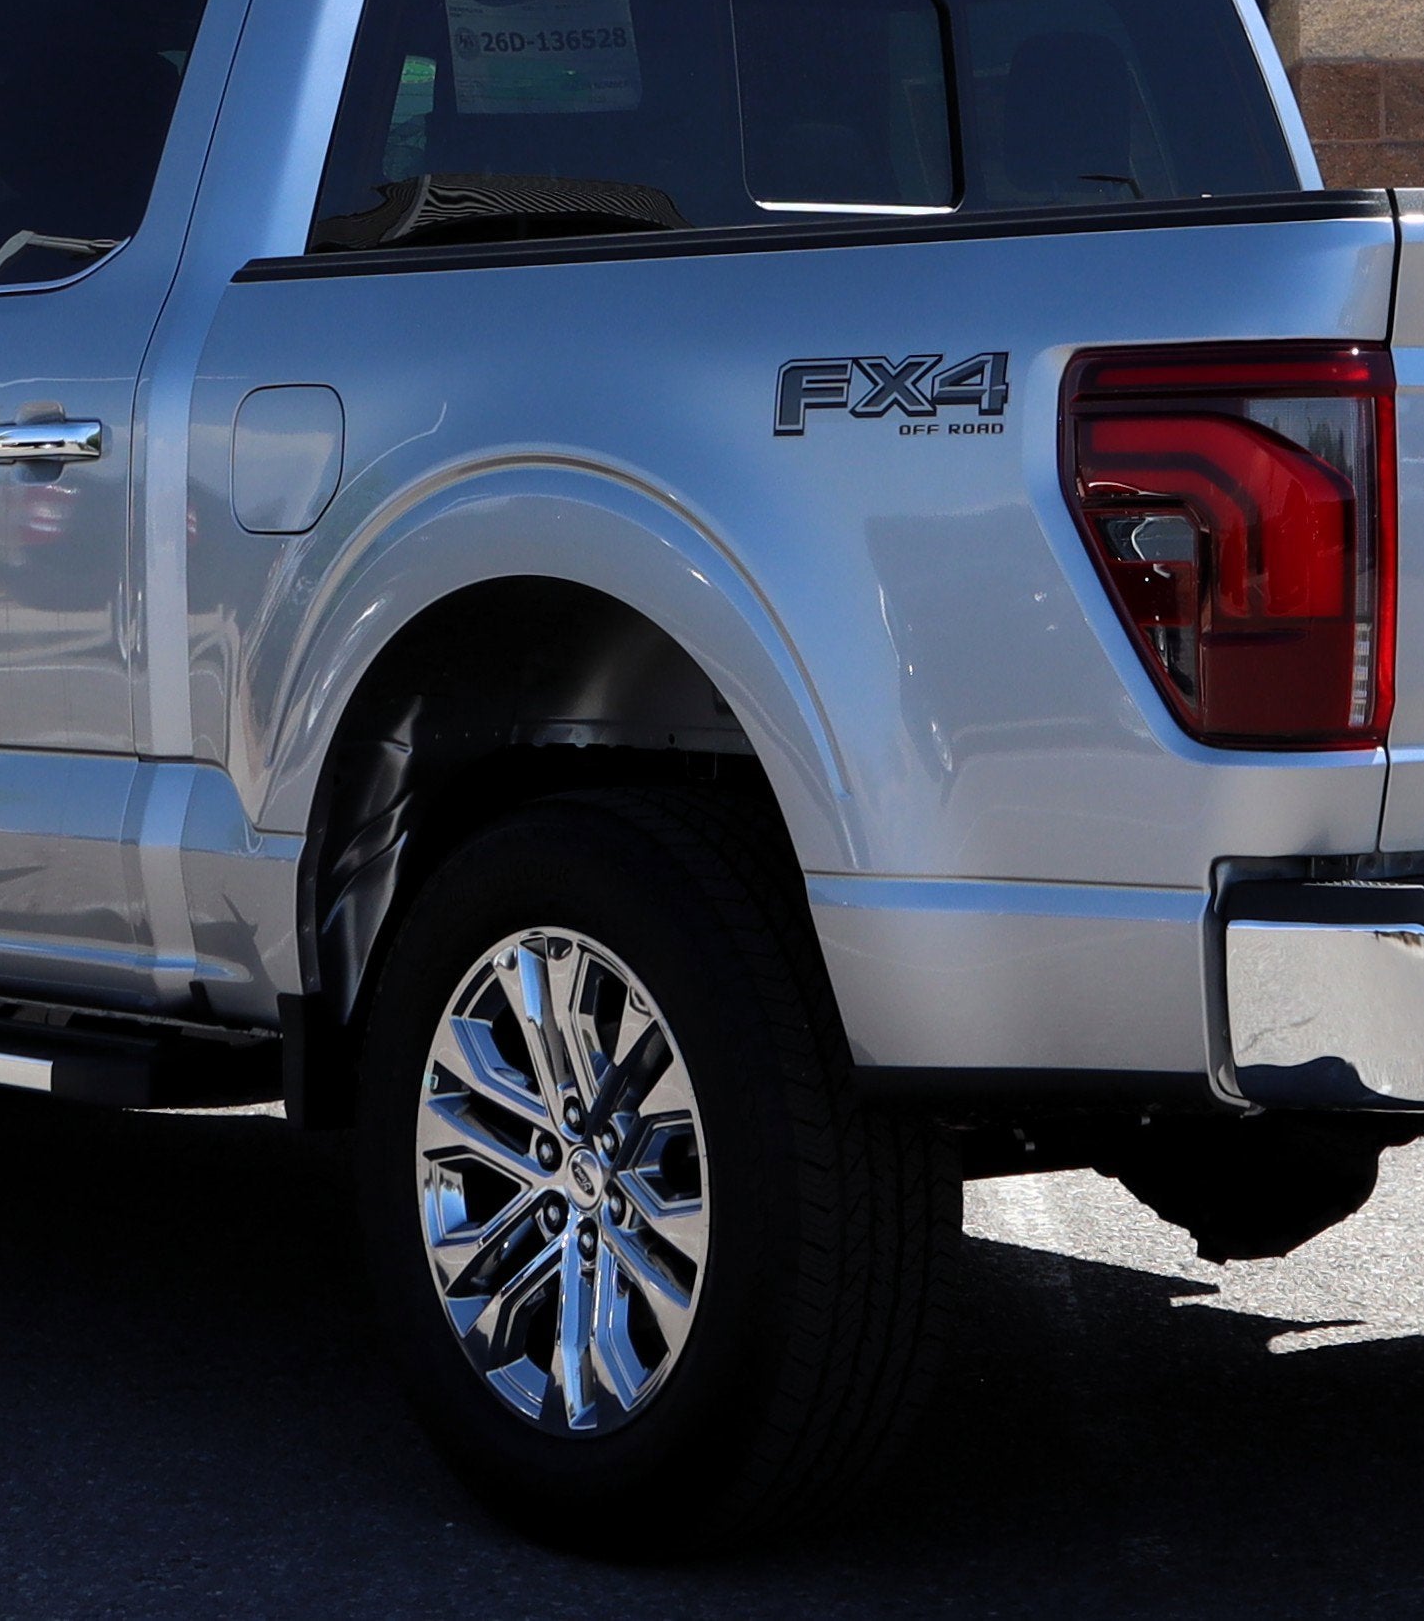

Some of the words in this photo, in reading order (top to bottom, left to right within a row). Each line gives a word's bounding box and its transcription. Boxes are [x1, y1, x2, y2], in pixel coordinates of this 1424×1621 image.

[480, 26, 627, 53] 26D-136528
[773, 351, 1010, 436] FX4
[899, 424, 940, 436] OFF
[948, 423, 1004, 435] ROAD
